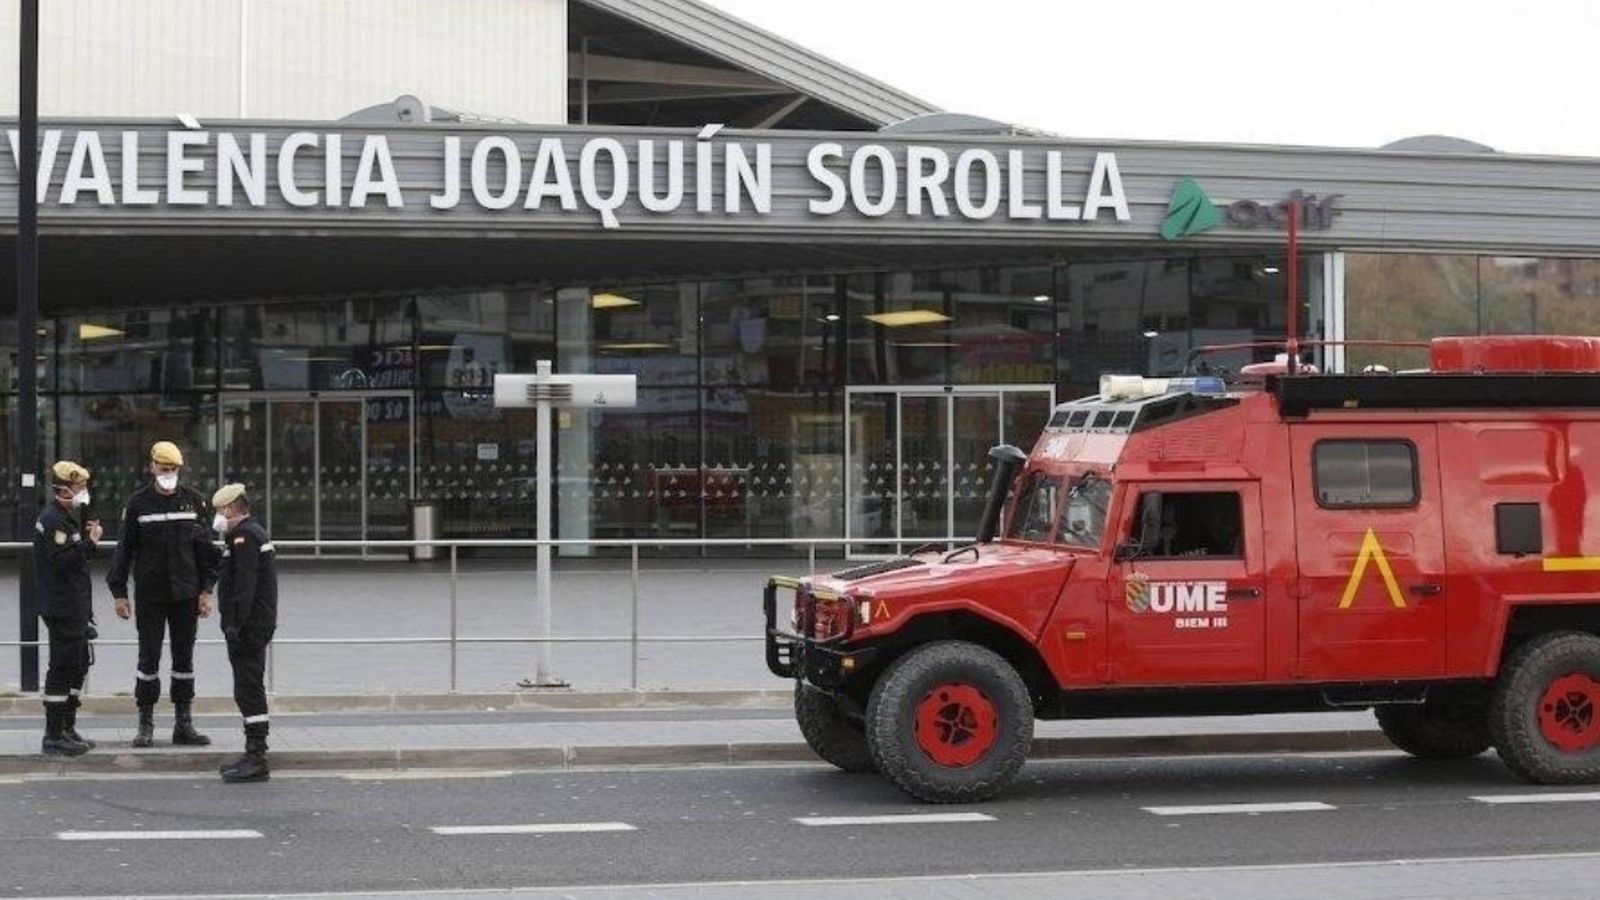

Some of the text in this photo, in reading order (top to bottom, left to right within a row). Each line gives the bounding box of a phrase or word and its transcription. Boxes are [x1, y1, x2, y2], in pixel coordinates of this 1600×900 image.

[7, 113, 1131, 228] VALÈNCIA JOAQUÍN SOROLLA
[1149, 583, 1228, 613] UME
